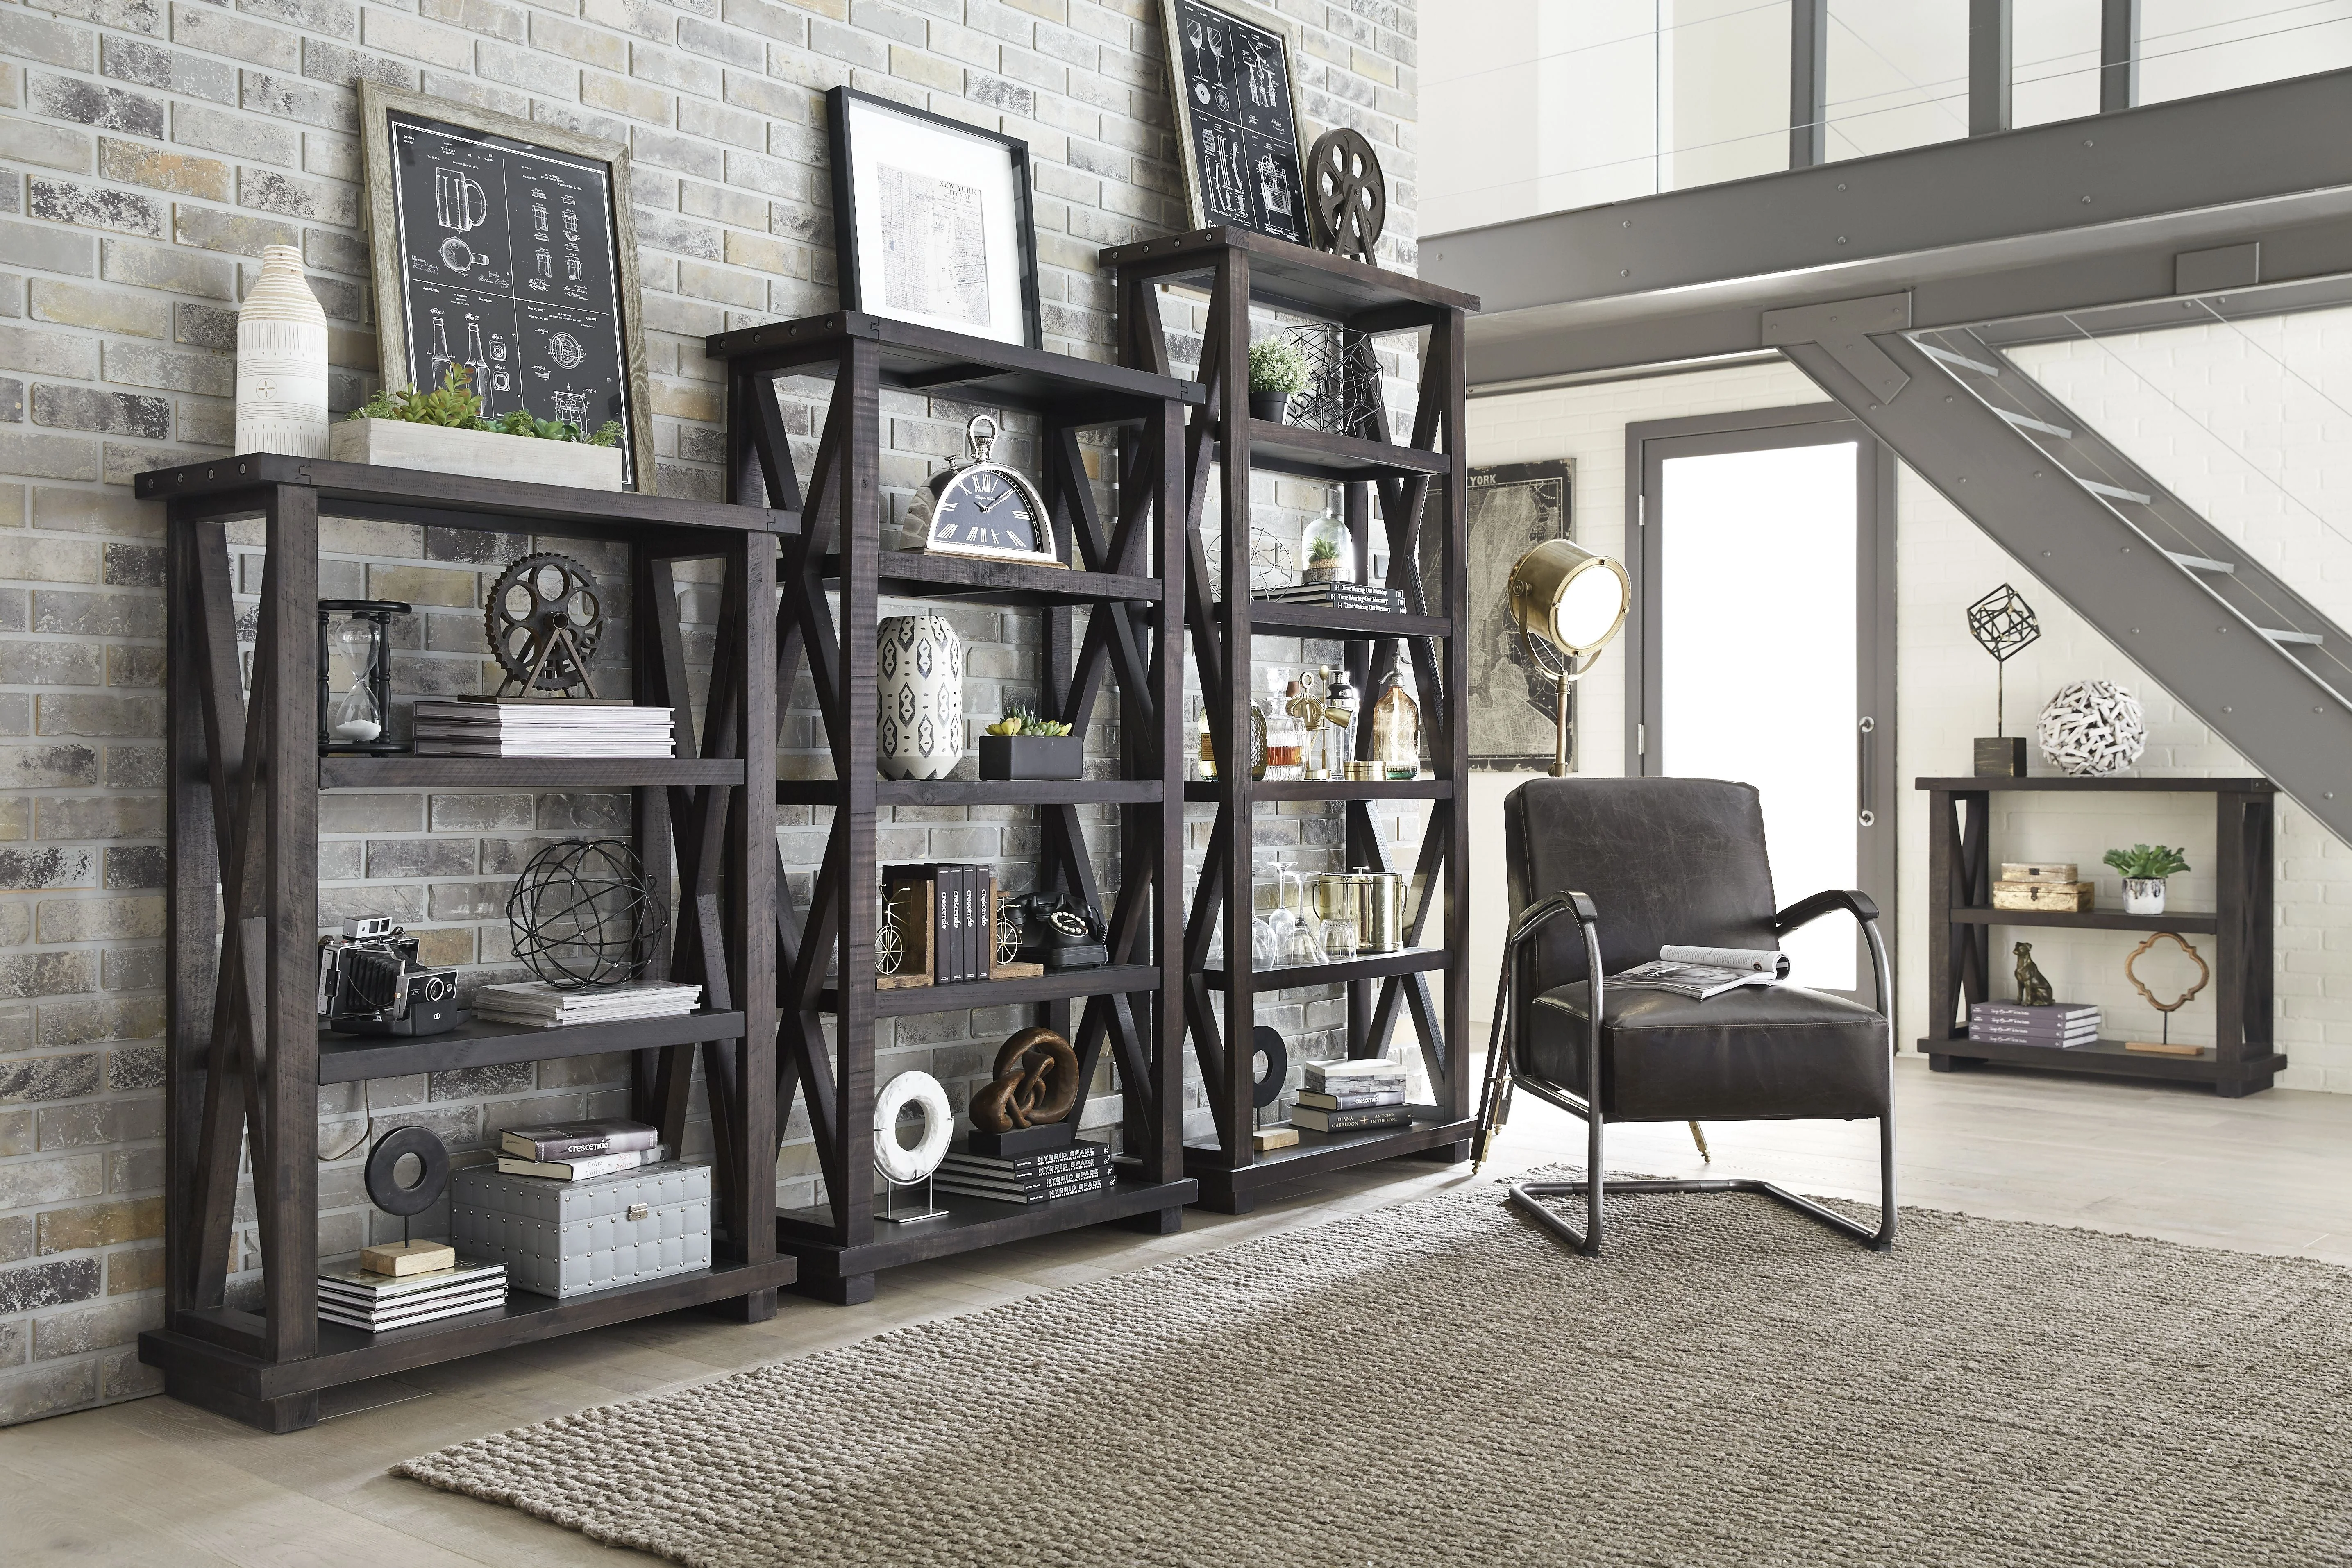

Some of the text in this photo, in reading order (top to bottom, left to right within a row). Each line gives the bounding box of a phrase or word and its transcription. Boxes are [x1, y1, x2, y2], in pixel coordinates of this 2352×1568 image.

[939, 180, 976, 195] NEW YORK
[1470, 474, 1496, 486] YORK
[1351, 585, 1365, 594] Wearing
[1373, 588, 1387, 597] Memory
[1348, 595, 1364, 603] Wearing
[1372, 597, 1388, 605] Memory
[953, 890, 961, 928] crescendo
[1355, 1095, 1378, 1104] crescendo
[568, 1139, 609, 1153] crescendo
[1038, 1147, 1094, 1162] HYBRID SPACE
[616, 1161, 634, 1170] Webster
[1039, 1158, 1095, 1173] HYBRID SPACE
[1046, 1169, 1099, 1185] HYBRID SPACE
[1049, 1179, 1102, 1196] HYBRID SPACE
